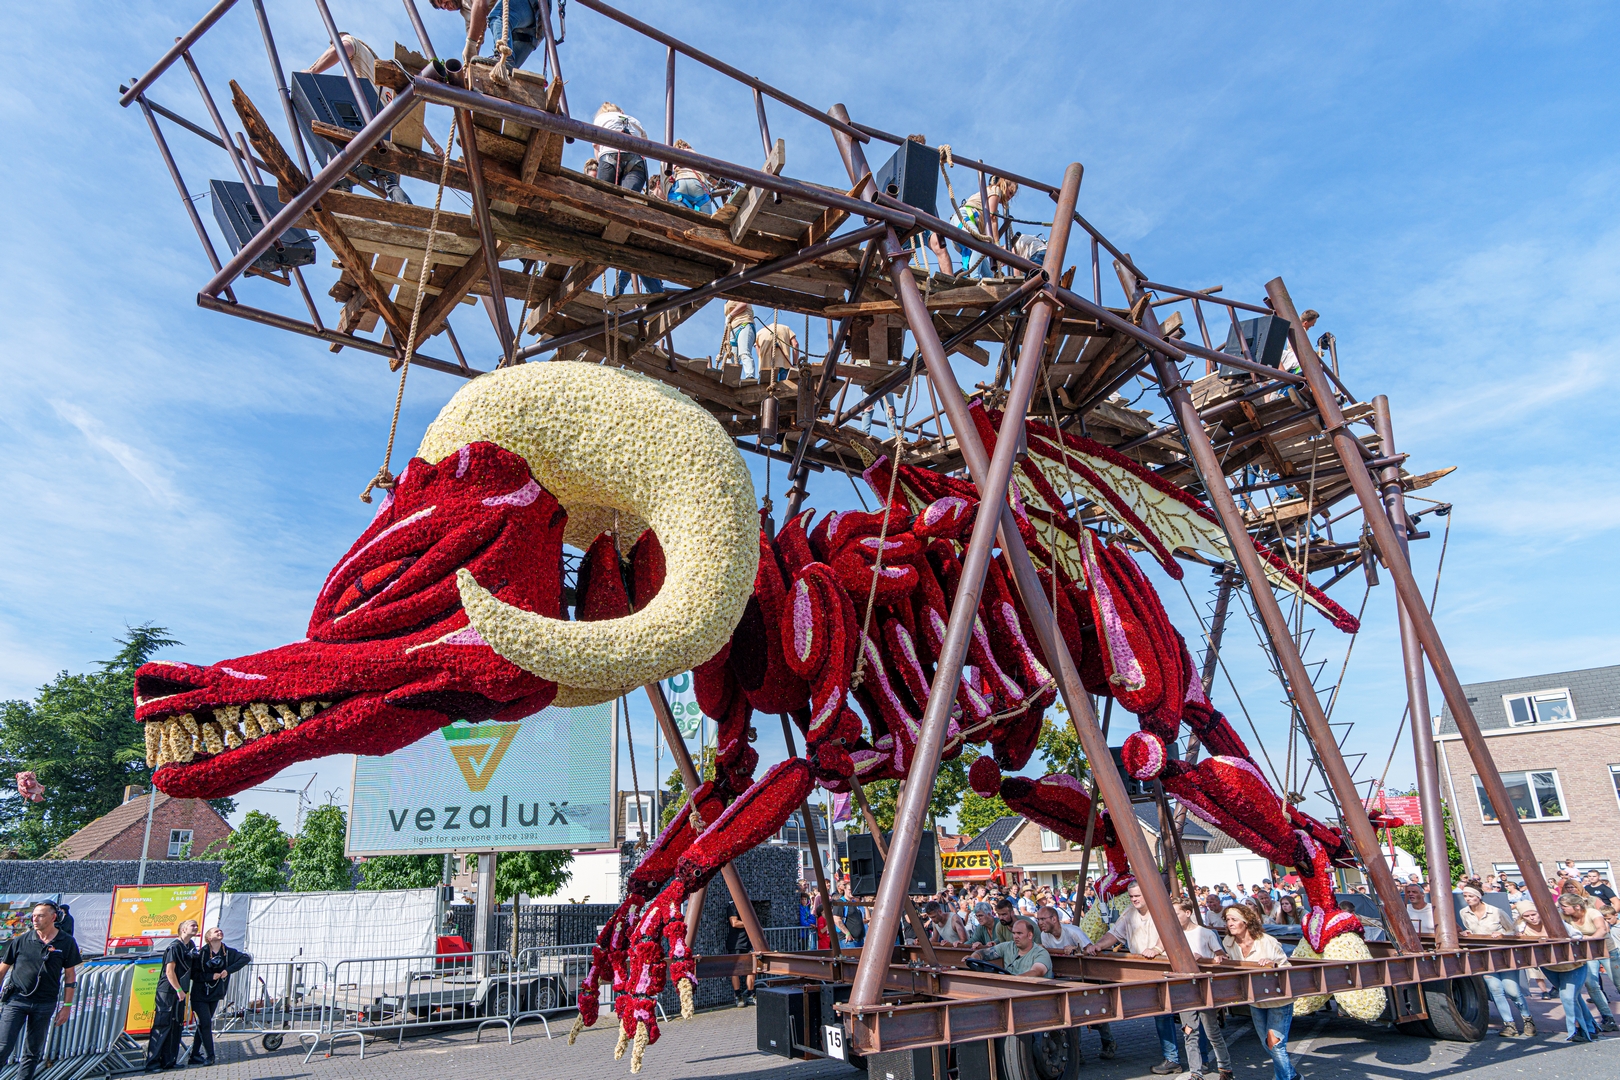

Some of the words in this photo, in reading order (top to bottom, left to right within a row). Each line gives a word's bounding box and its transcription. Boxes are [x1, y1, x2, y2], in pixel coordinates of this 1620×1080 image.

[388, 795, 569, 831] vezalux
[413, 835, 433, 845] light
[436, 835, 448, 843] for
[451, 834, 491, 844] everyone
[494, 833, 517, 841] since
[520, 832, 538, 840] 1991
[828, 1030, 841, 1048] 15
